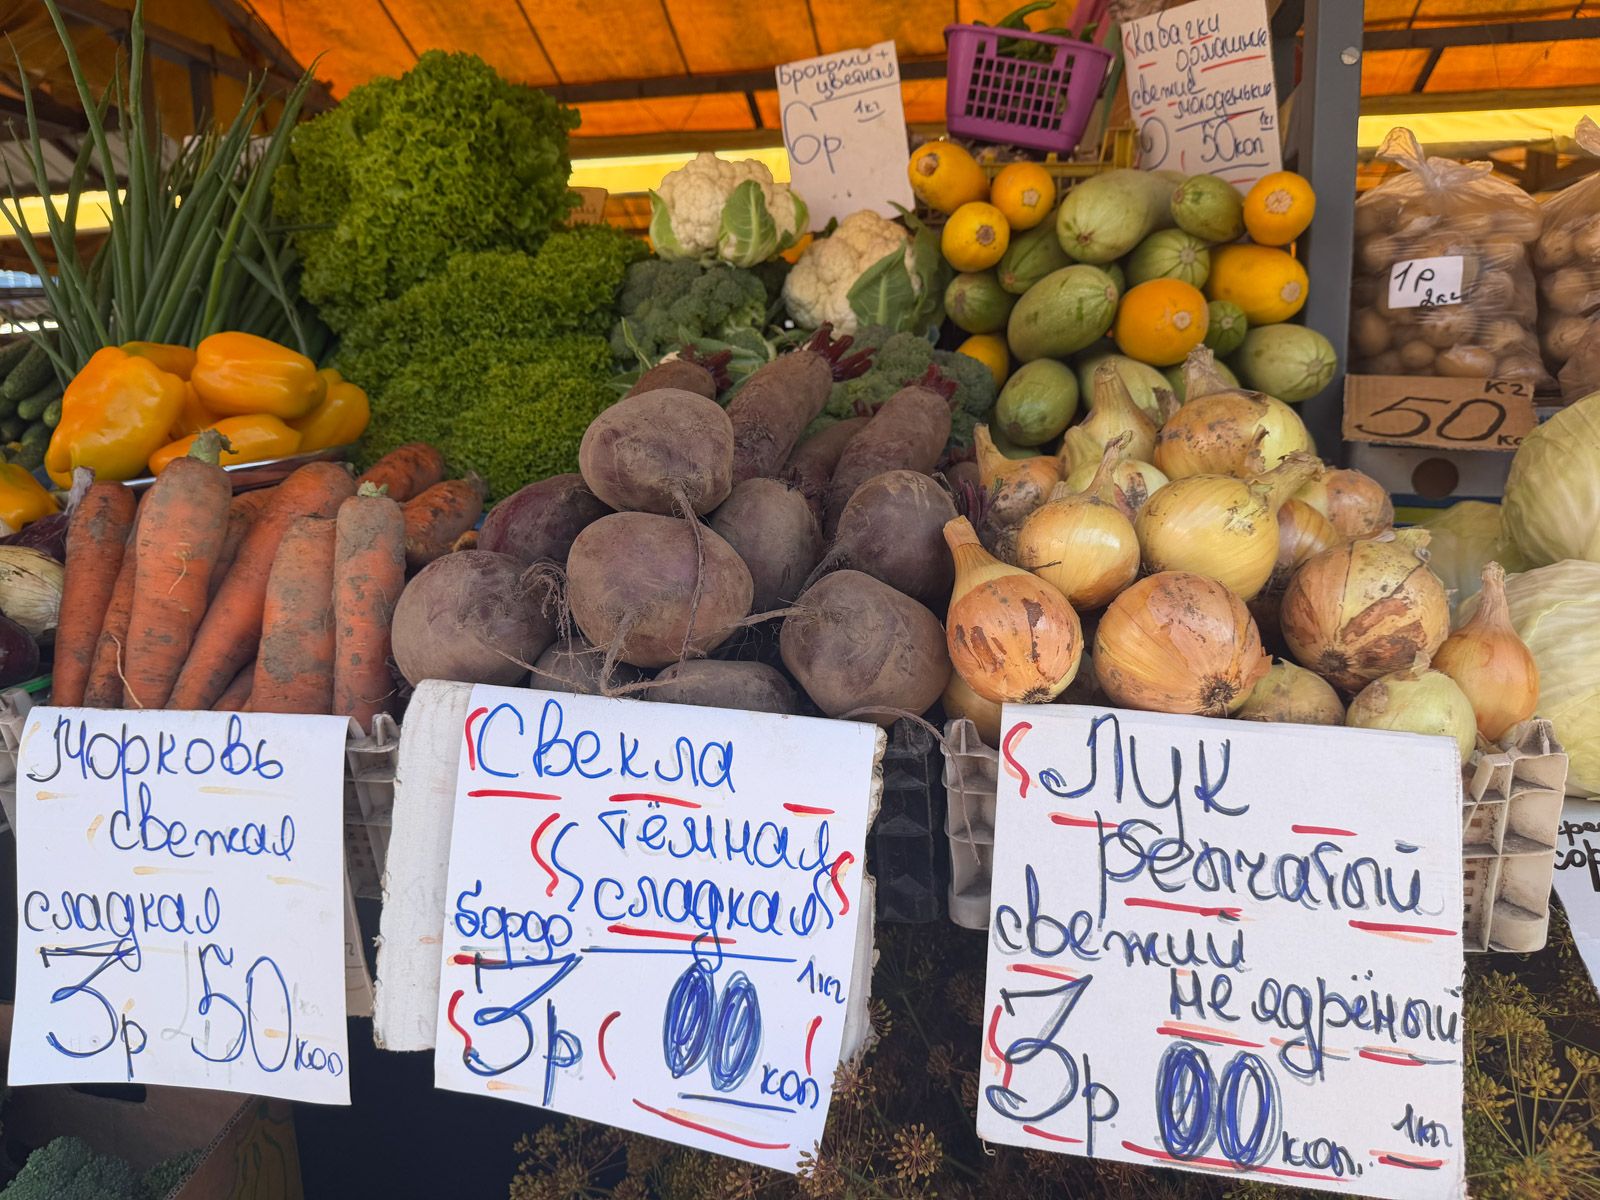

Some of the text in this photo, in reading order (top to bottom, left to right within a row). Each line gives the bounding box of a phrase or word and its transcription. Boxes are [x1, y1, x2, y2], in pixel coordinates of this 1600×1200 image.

[1132, 10, 1220, 57] Кабачки
[1354, 396, 1507, 442] 50
[27, 713, 284, 830] Морковь
[476, 699, 736, 793] Свекла
[1038, 712, 1250, 858] Лук
[110, 781, 295, 861] свежая
[24, 886, 220, 972] сладкая
[454, 880, 573, 970] бордо
[594, 875, 817, 974] сладкая
[994, 864, 1250, 972] свежий
[1169, 968, 1240, 1022] не
